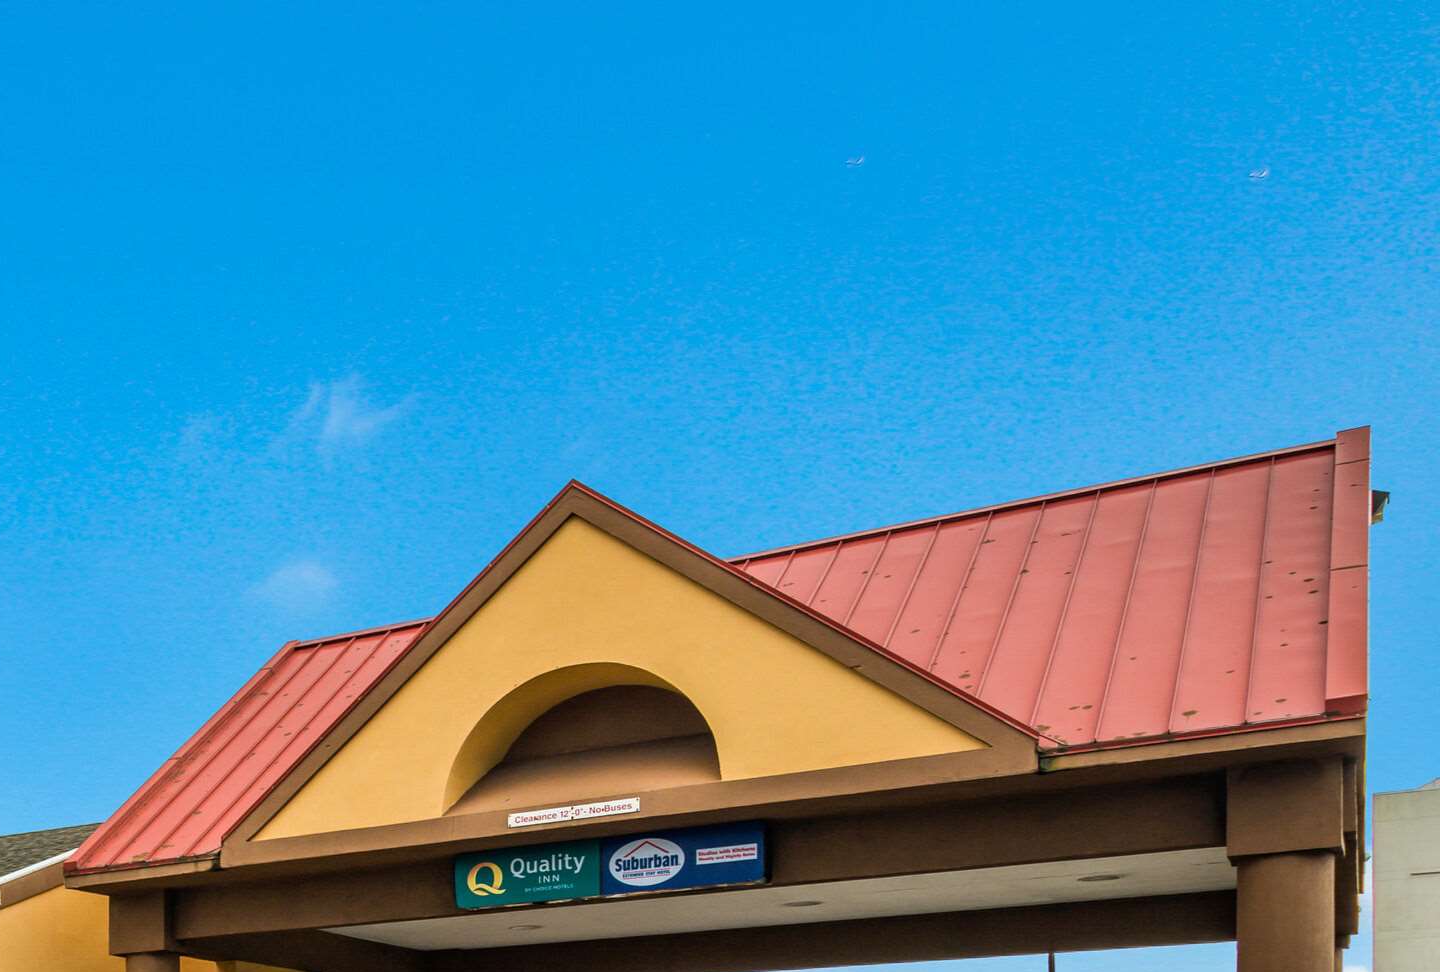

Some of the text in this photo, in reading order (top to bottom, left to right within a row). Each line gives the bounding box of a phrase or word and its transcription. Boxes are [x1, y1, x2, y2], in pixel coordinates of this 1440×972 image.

[514, 812, 557, 824] Clearance
[604, 803, 633, 813] Buses
[510, 854, 585, 878] Quality
[615, 854, 679, 872] Suburban
[538, 874, 560, 884] INN
